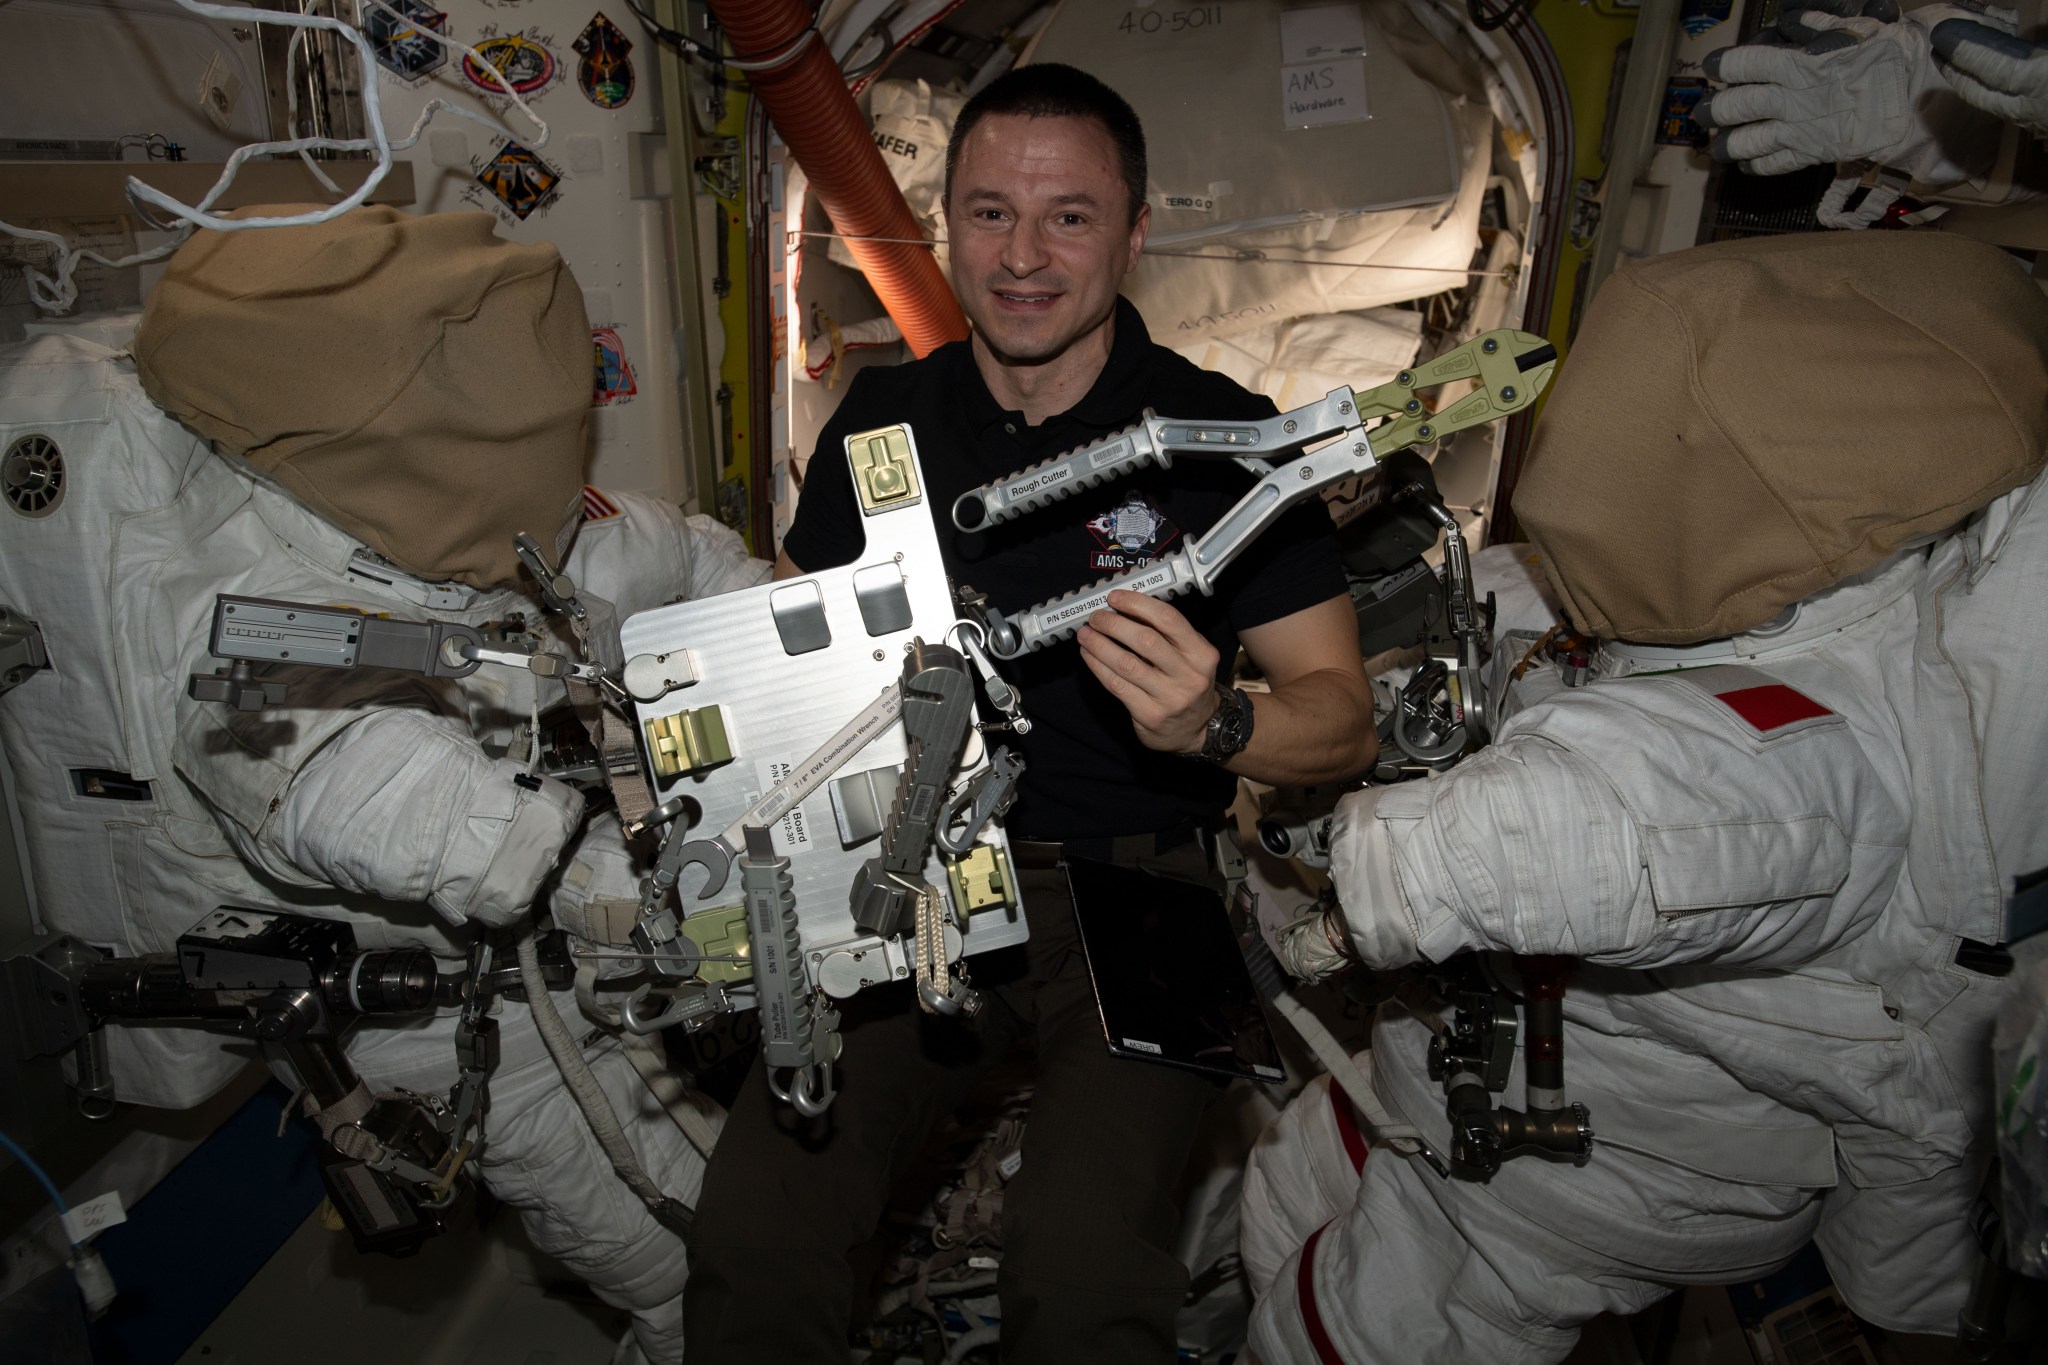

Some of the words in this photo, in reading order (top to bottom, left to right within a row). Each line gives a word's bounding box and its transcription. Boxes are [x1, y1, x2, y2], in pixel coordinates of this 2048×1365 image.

[1118, 6, 1222, 34] 40-5011
[1287, 67, 1334, 92] AMS
[1289, 97, 1346, 114] Hardware
[873, 131, 919, 160] AFER
[1164, 197, 1193, 208] ZERO
[1011, 481, 1040, 497] Rough
[1041, 468, 1068, 485] Cutter
[1097, 554, 1124, 567] AMS
[1046, 613, 1060, 625] P/N
[1132, 581, 1146, 592] S/N
[1147, 574, 1164, 587] 1003
[810, 761, 825, 775] EVA
[823, 733, 859, 763] Combination
[856, 715, 880, 735] Wrench
[769, 764, 778, 777] P/N
[792, 812, 807, 843] Board
[766, 945, 775, 960] 1001
[769, 962, 777, 974] S/N
[770, 1002, 779, 1021] Puller
[774, 1022, 782, 1039] Tube
[1130, 1040, 1155, 1051] DREW
